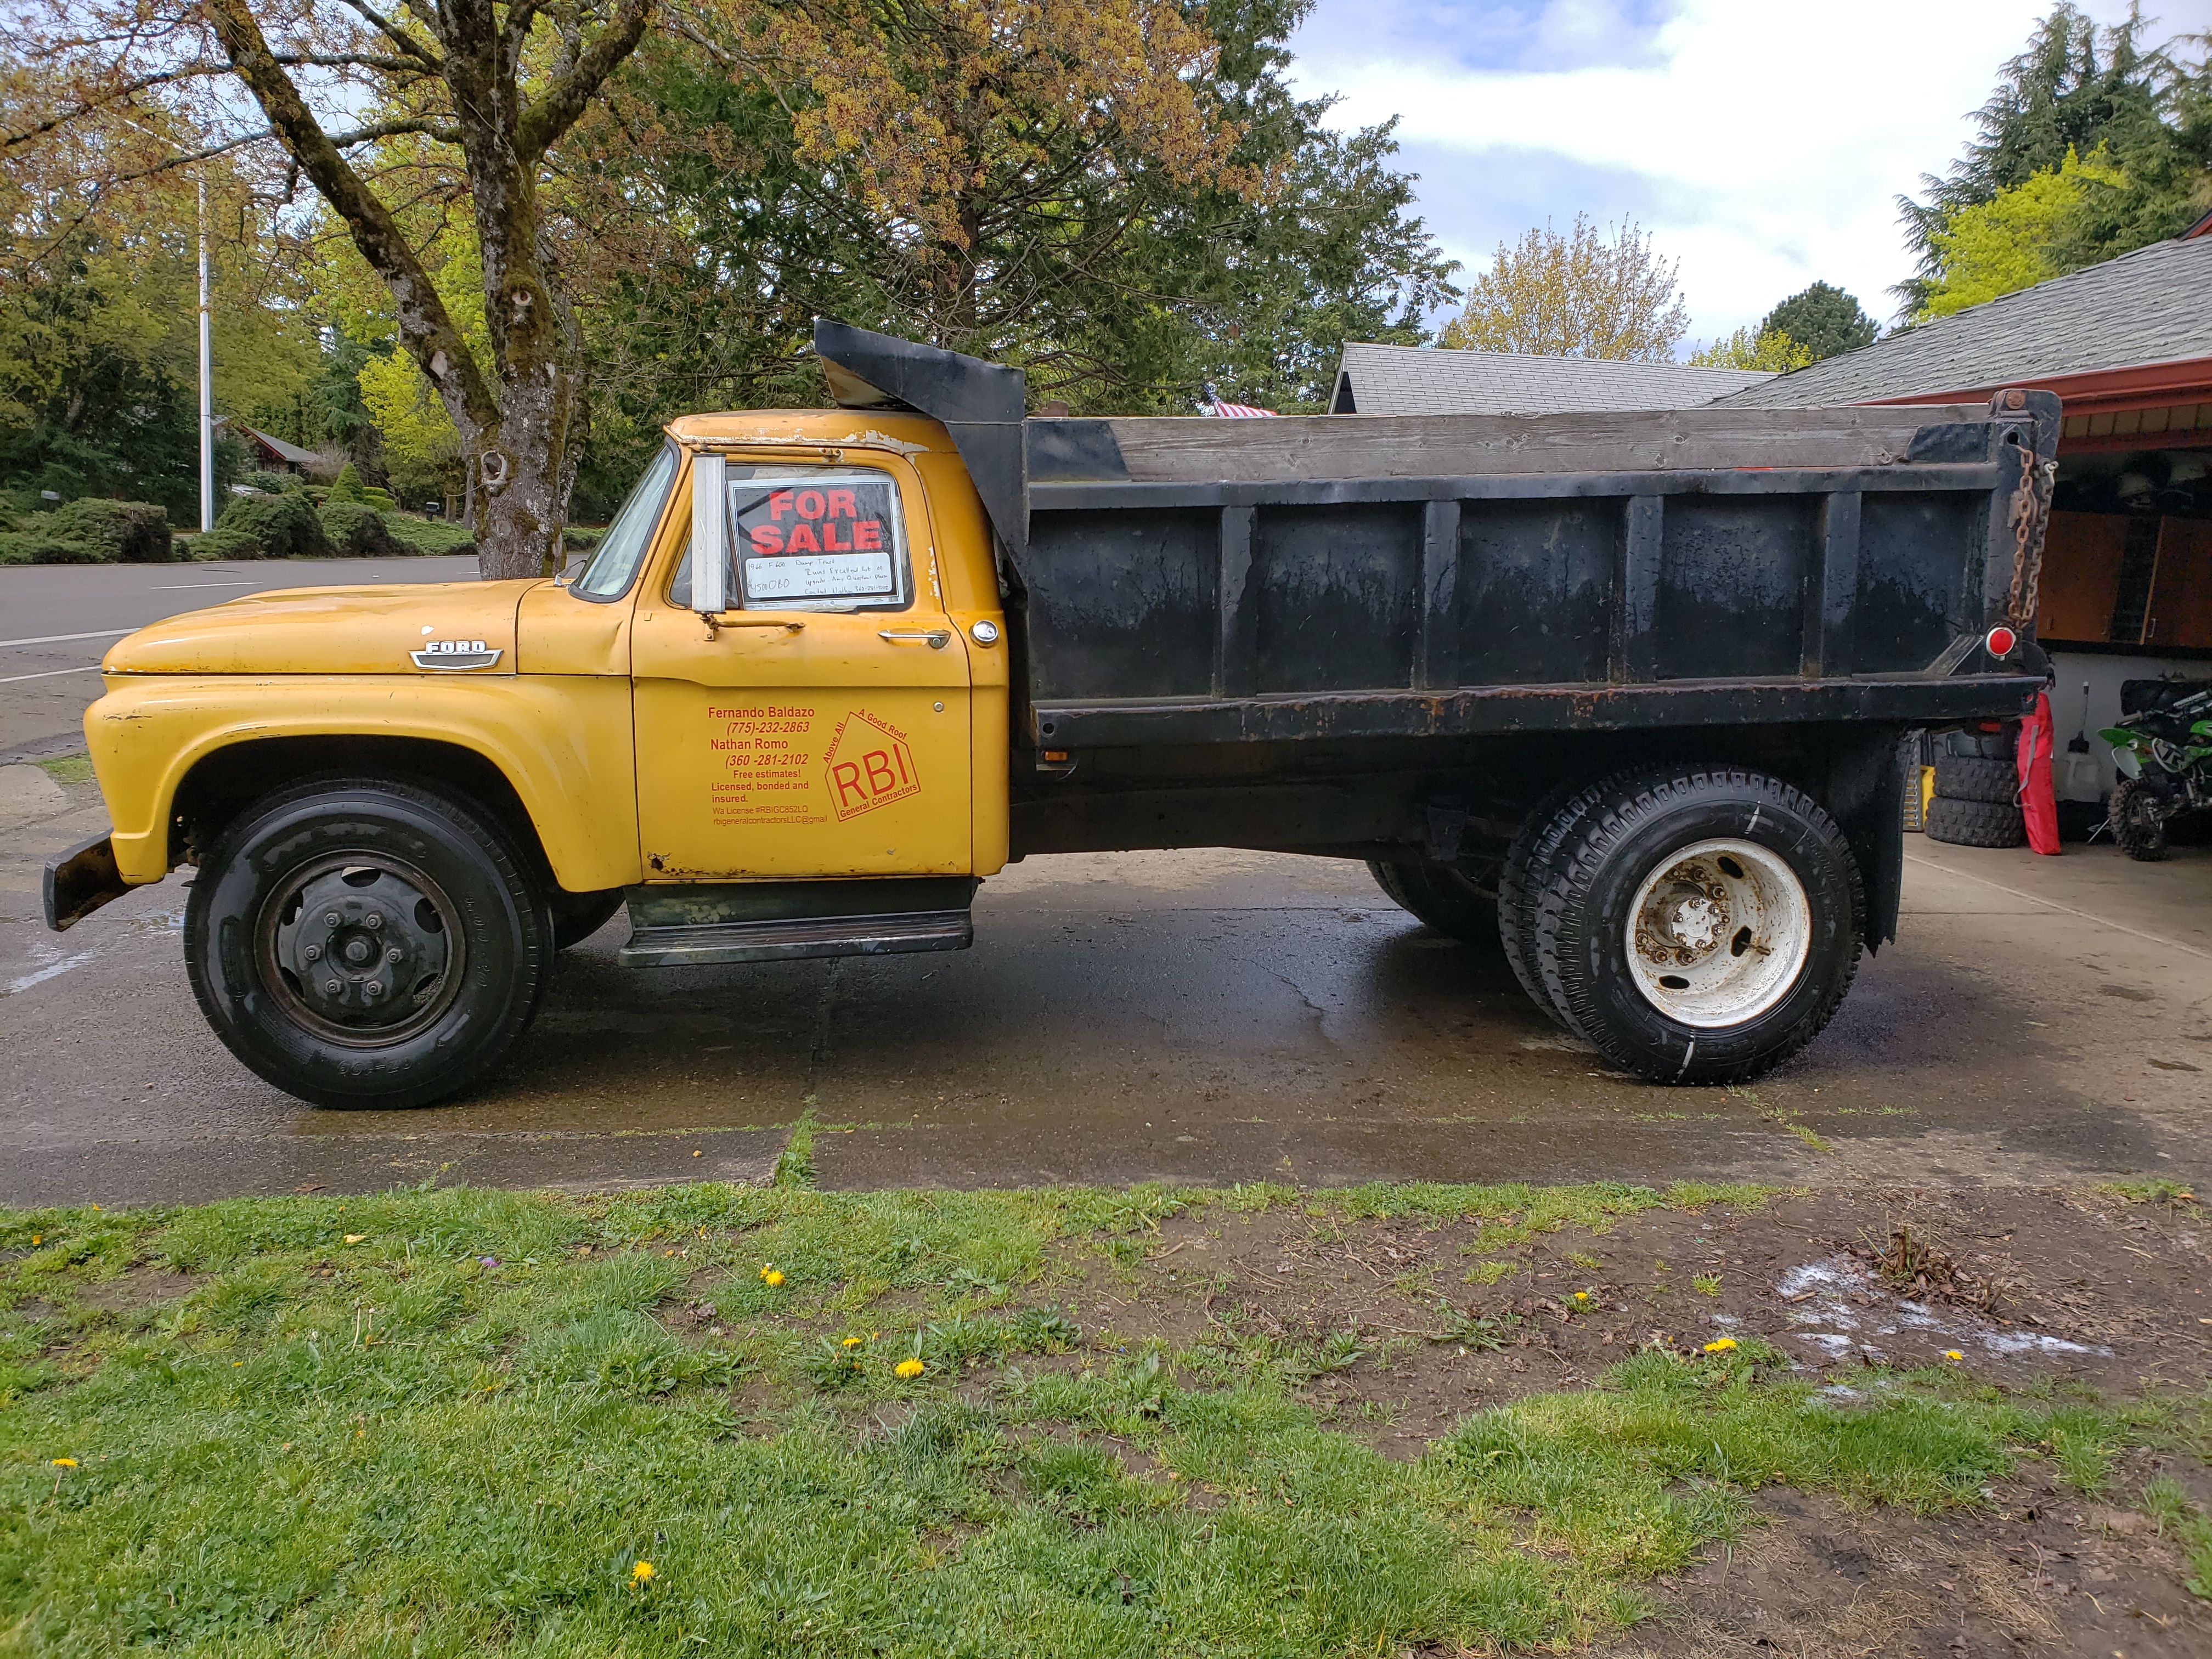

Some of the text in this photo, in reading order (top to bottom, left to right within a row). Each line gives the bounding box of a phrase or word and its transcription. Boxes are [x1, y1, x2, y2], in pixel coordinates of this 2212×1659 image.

[769, 489, 857, 521] FOR
[750, 520, 883, 554] SALE
[426, 640, 486, 654] FORD
[708, 706, 815, 718] Fernando Baldazo
[727, 721, 810, 736] (775)-232-2863
[858, 708, 908, 740] A Good Roof
[711, 738, 788, 750] Nathan Romo
[823, 721, 844, 764] Above All
[733, 769, 801, 778] Free estimates!
[832, 743, 909, 807] RBI
[712, 781, 809, 792] Licensed, bonded and
[712, 794, 748, 803] insured.
[840, 784, 917, 817] General Contractors
[713, 815, 827, 826] rbigeneralcontractorsLLC@gmail
